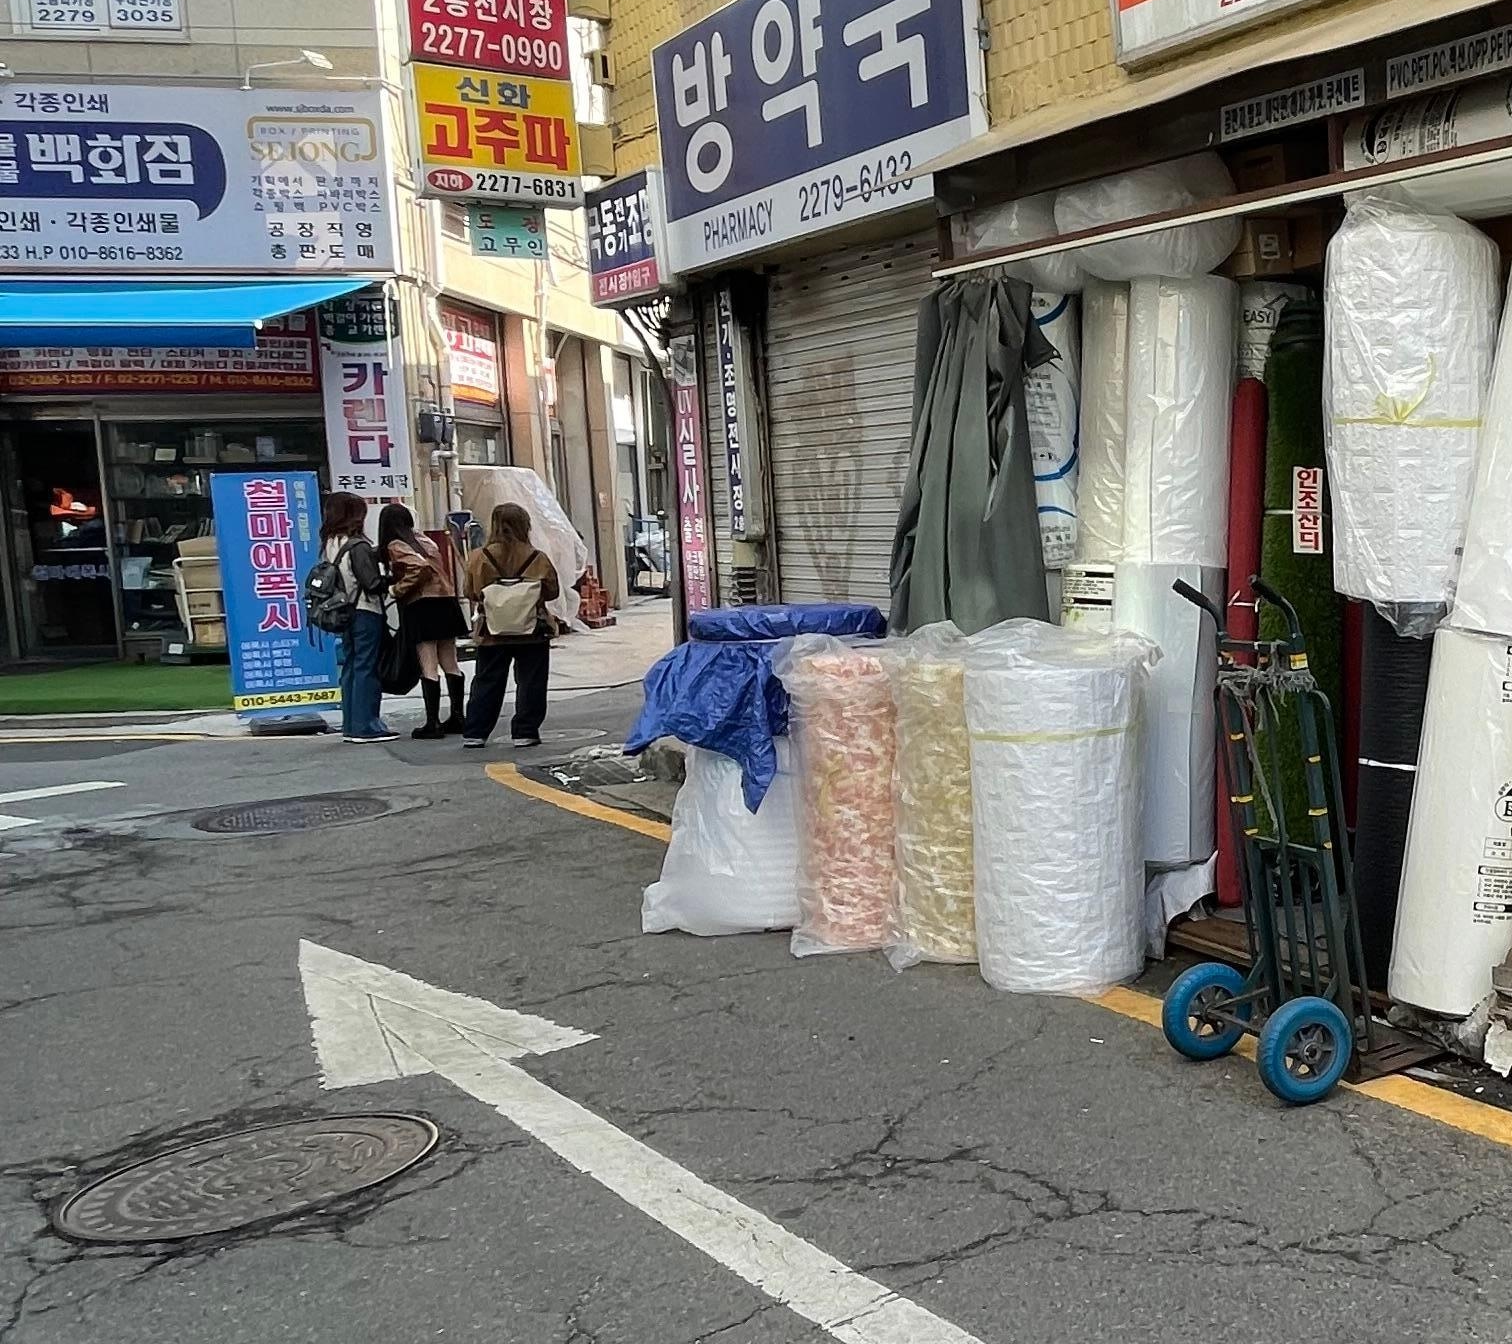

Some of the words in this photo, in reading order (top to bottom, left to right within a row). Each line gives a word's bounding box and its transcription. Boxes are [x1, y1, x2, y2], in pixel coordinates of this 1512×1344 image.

[37, 9, 96, 23] 2279
[116, 9, 174, 23] 3035
[421, 22, 562, 70] 2277-0990
[14, 93, 110, 114] 각종인쇄
[456, 77, 531, 109] 신화
[424, 102, 571, 171] 고주파
[25, 133, 196, 186] 백화점
[249, 141, 361, 163] SEJONG
[475, 173, 576, 198] 2277-6831
[66, 212, 181, 234] 각종인쇄물
[704, 198, 774, 252] PHARMACY
[59, 245, 184, 261] 010-8616-8362
[479, 236, 543, 256] 고무인
[1242, 309, 1272, 324] EASY
[341, 362, 395, 468] 카렌다
[243, 478, 301, 633] 철마에폭시
[241, 689, 337, 708] 010-5443-7687
